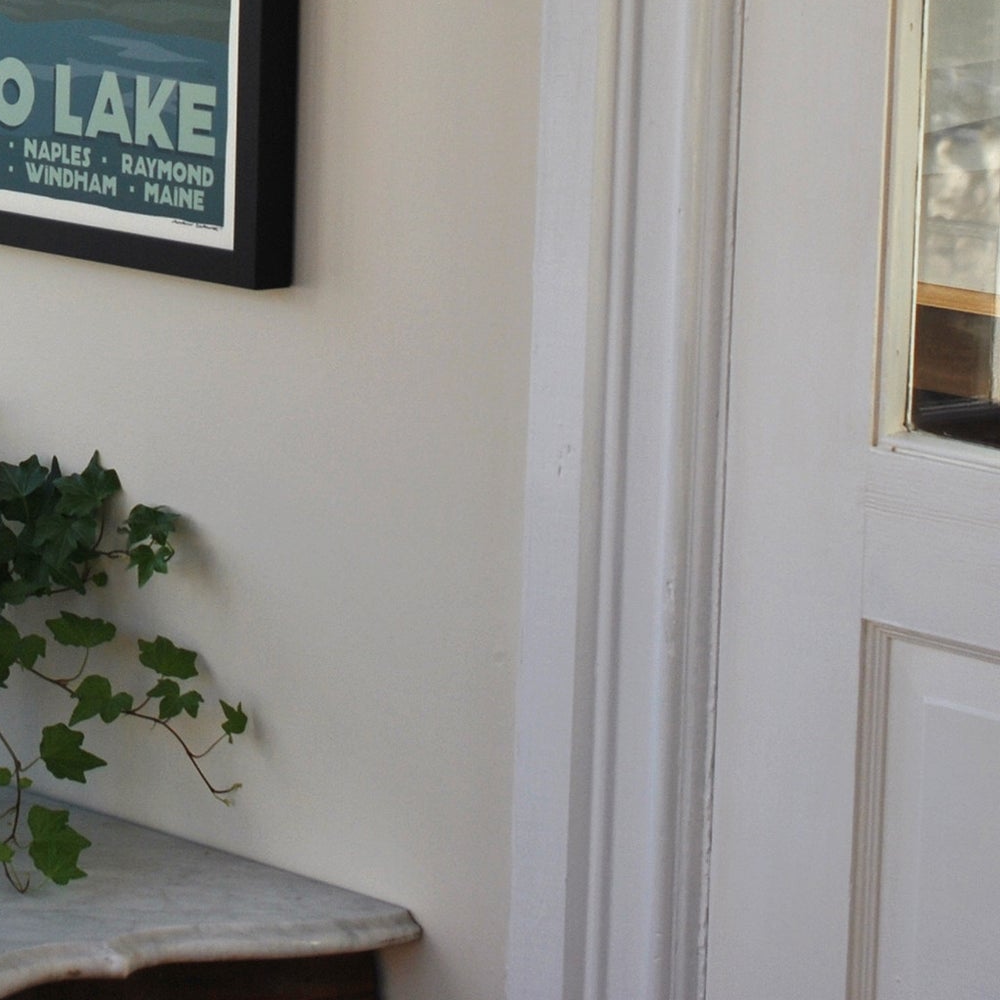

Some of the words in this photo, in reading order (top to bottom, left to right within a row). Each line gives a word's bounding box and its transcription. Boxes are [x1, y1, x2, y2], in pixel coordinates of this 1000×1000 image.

[54, 63, 217, 157] LAKE
[23, 137, 92, 168] NAPLES
[121, 152, 214, 188] RAYMOND
